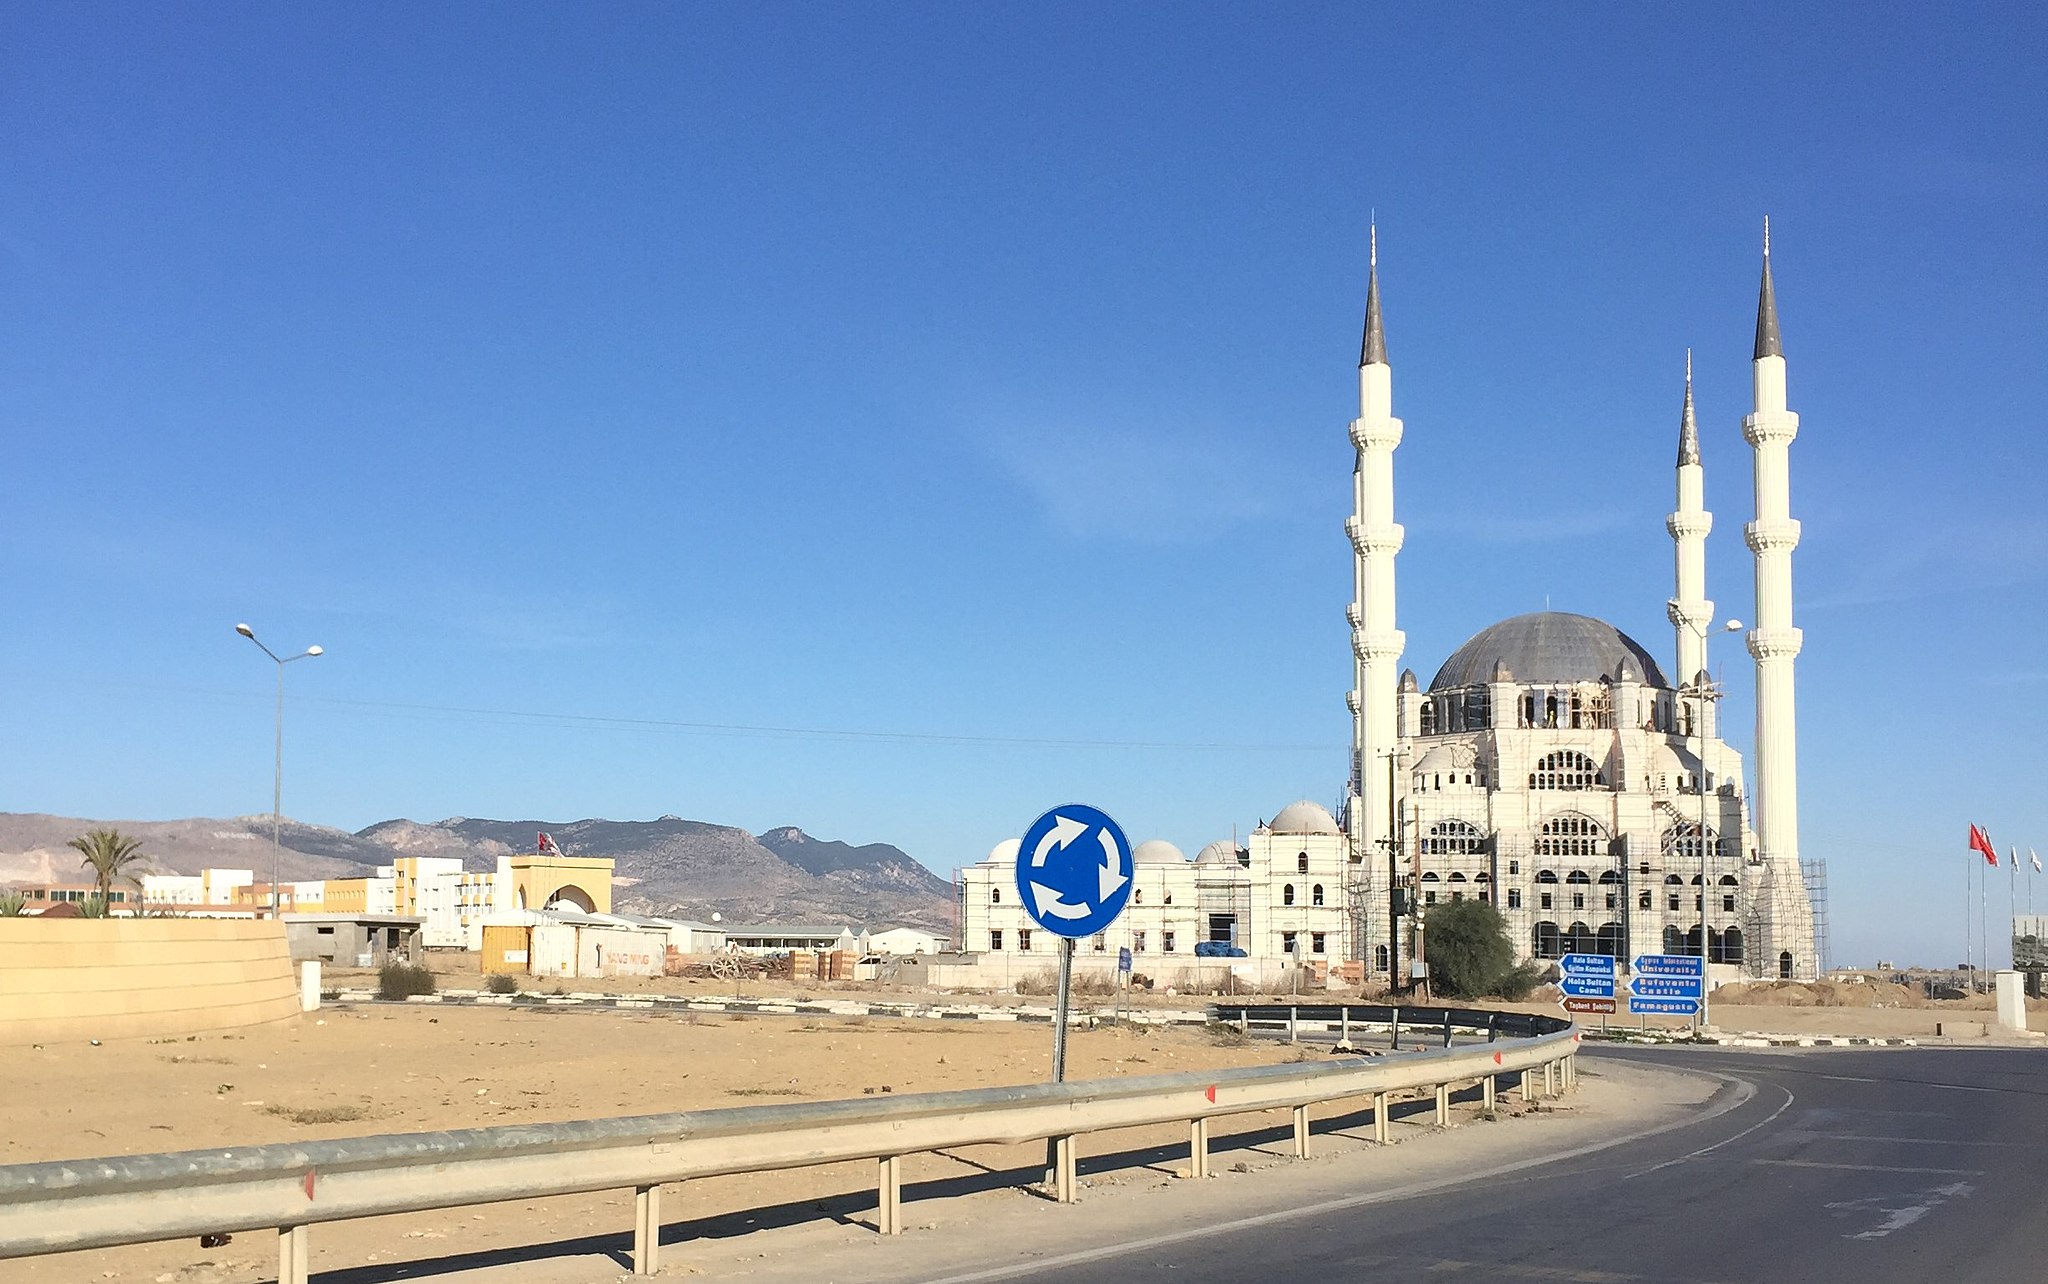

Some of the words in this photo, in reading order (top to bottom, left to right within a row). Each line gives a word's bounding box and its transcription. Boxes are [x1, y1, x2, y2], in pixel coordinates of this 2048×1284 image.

[606, 953, 628, 965] YANG
[1641, 965, 1697, 975] University
[1567, 977, 1586, 986] Hala
[1586, 979, 1612, 987] Sultan
[1633, 1001, 1694, 1012] Famagusta
